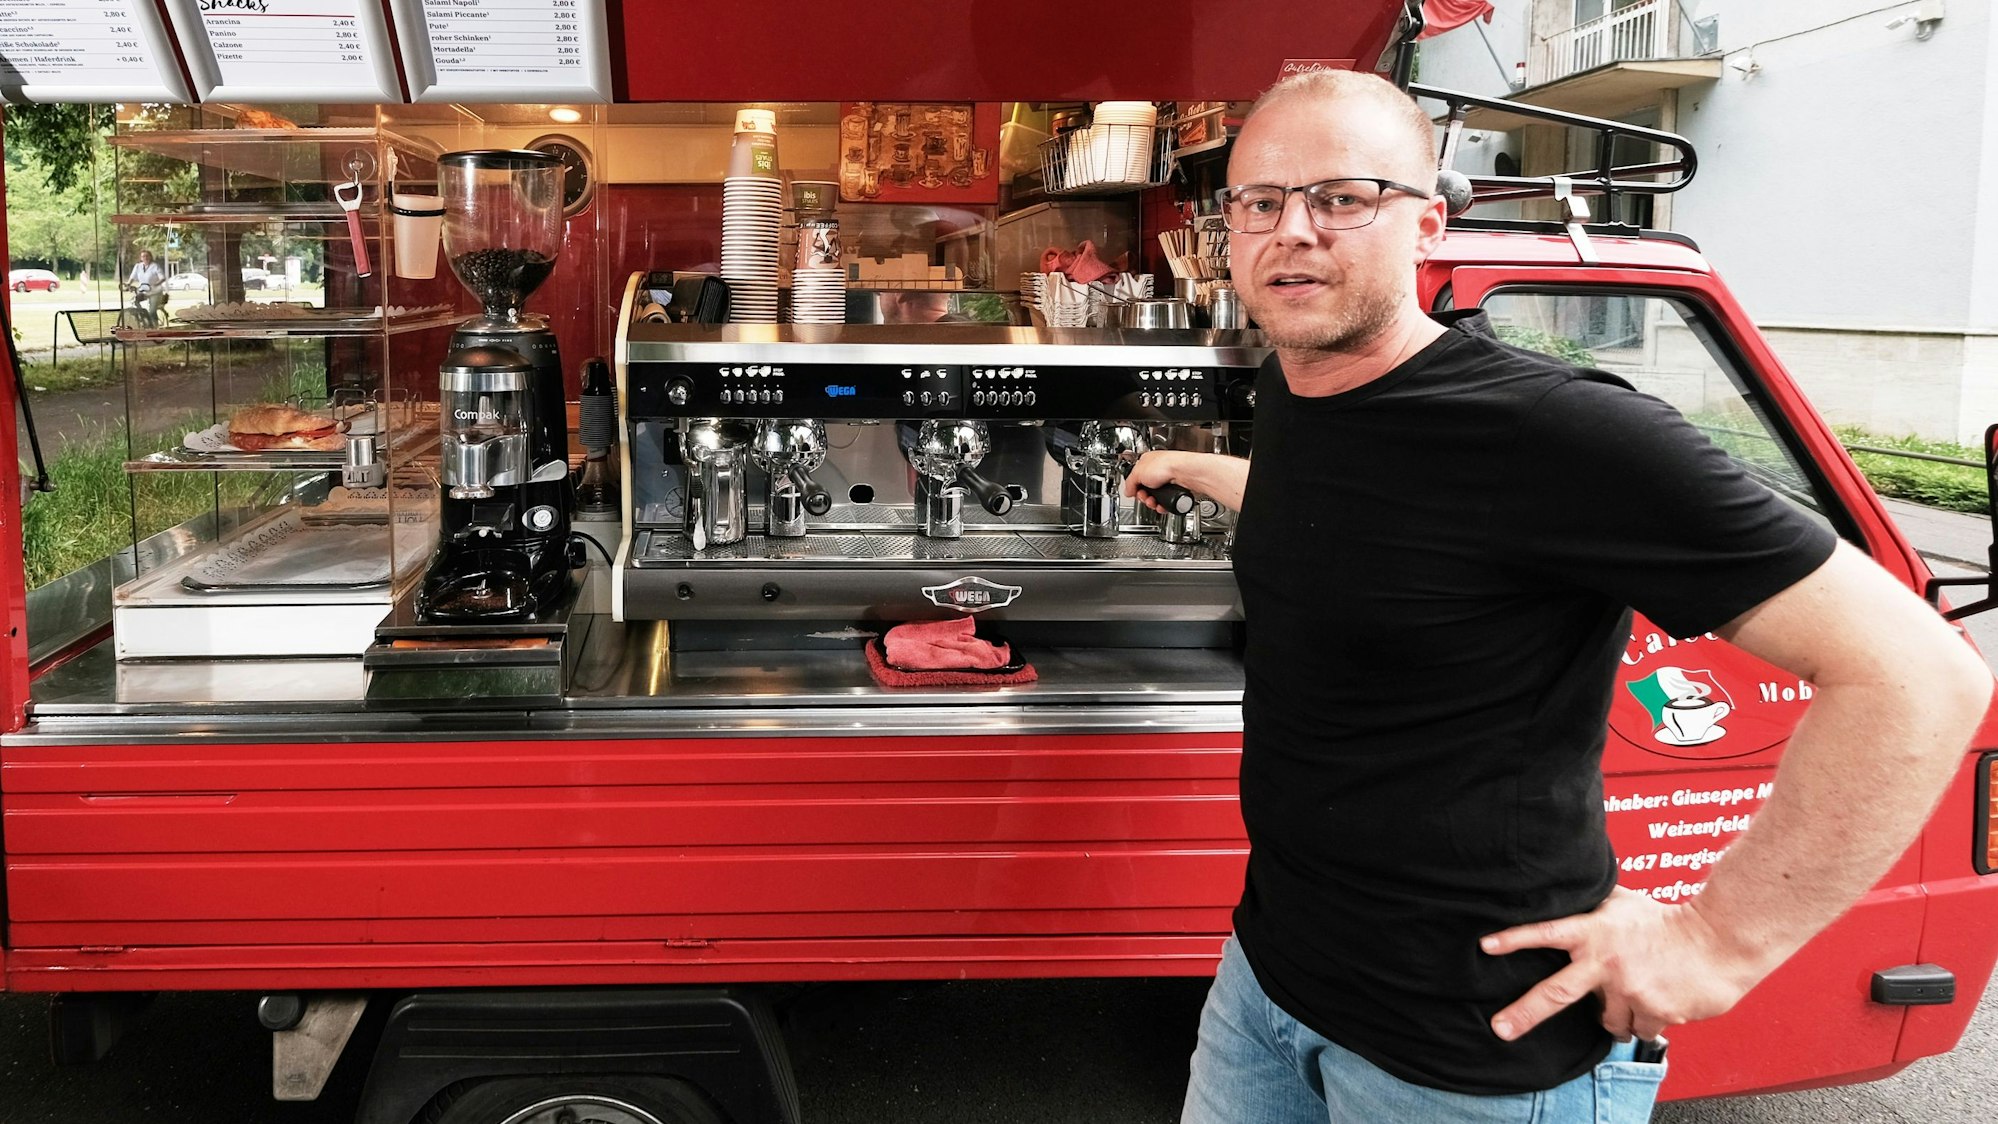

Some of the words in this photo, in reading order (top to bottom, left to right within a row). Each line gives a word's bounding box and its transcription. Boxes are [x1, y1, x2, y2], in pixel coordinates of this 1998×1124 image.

[757, 160, 771, 170] ibis
[803, 190, 817, 199] ibis
[827, 384, 856, 398] WEGA
[454, 408, 500, 422] Compak
[955, 590, 991, 602] WEGA
[1757, 679, 1813, 703] Mob
[1671, 788, 1754, 806] Giuseppe
[1756, 782, 1774, 799] M
